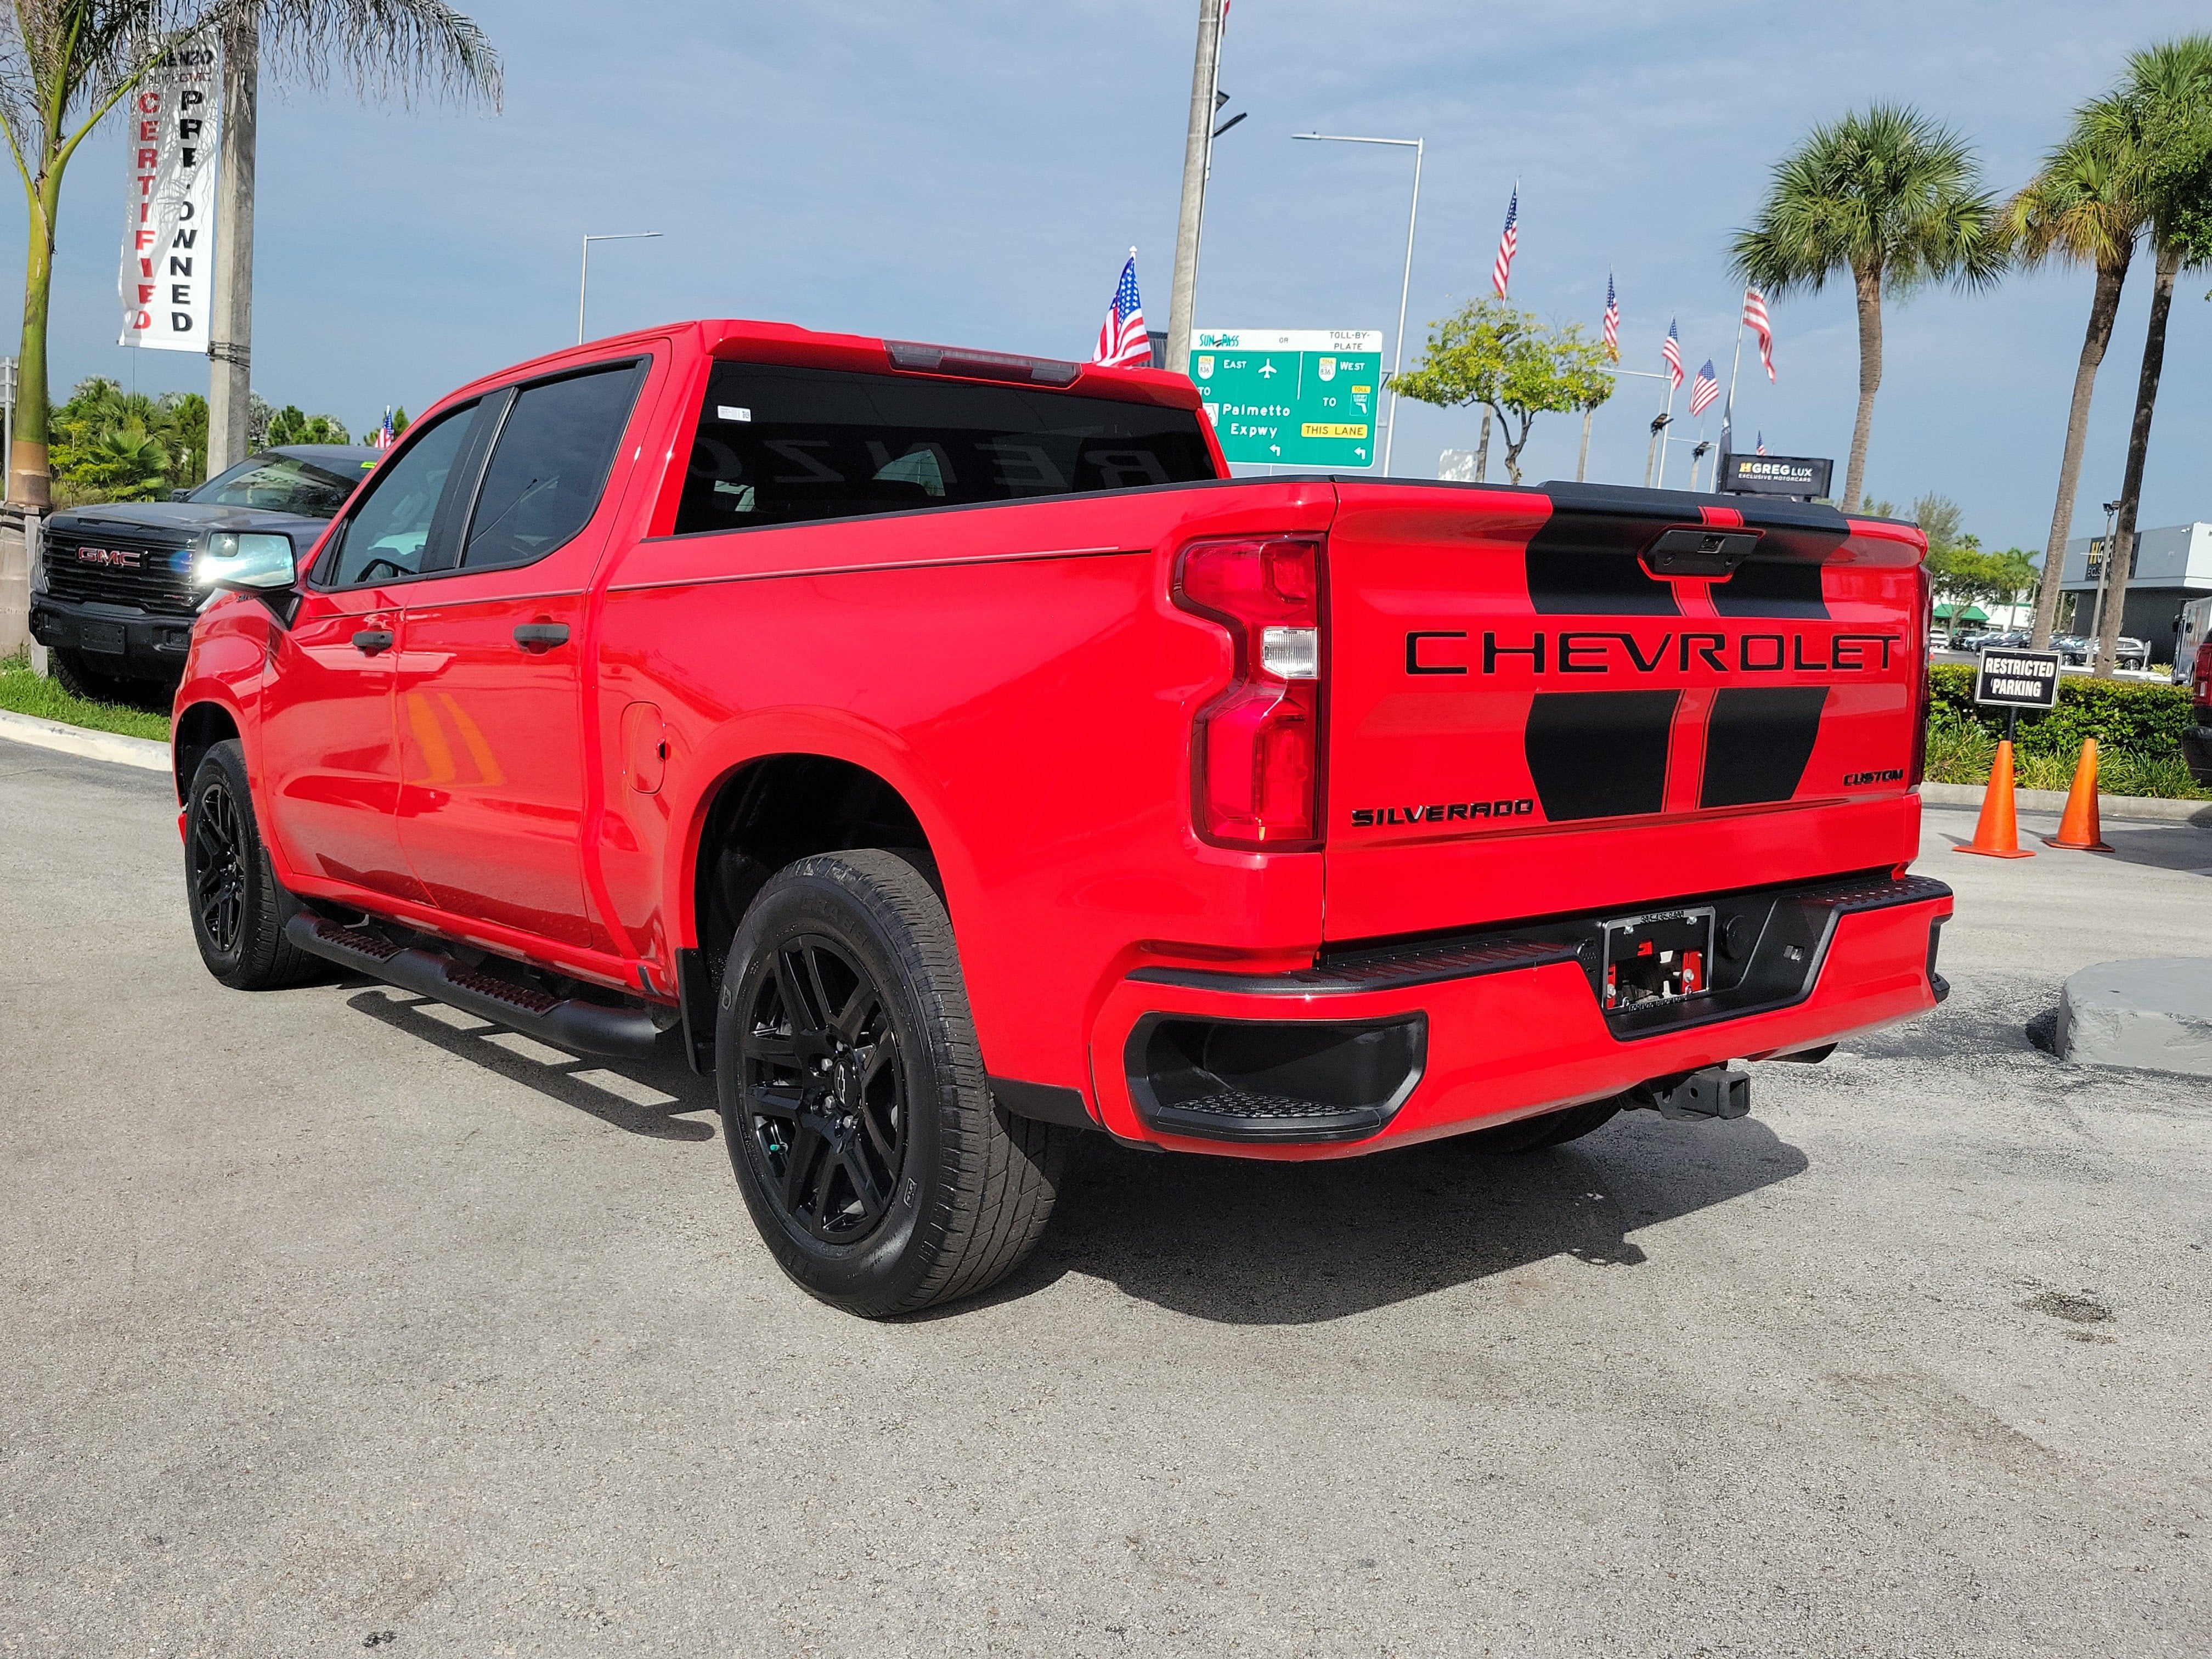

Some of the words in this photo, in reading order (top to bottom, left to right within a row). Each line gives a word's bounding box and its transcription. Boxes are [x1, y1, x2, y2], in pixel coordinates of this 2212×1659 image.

[133, 92, 160, 330] CERTIFIED
[1223, 359, 1247, 369] EAST
[1340, 361, 1365, 371] WEST
[1197, 386, 1211, 396] TO
[1222, 403, 1290, 417] Palmetto
[1322, 397, 1337, 407] TO
[1230, 422, 1278, 439] Expwy
[1305, 426, 1329, 435] THIS
[1334, 426, 1364, 436] LANE
[1791, 467, 1813, 477] LUX
[78, 547, 141, 567] GMC
[1405, 630, 1901, 675] CHEVROLET
[1984, 657, 2055, 678] RESTRICTED
[1991, 678, 2042, 698] PARKING
[1843, 769, 1904, 787] CUSTOM
[1351, 798, 1534, 827] SILVERADO
